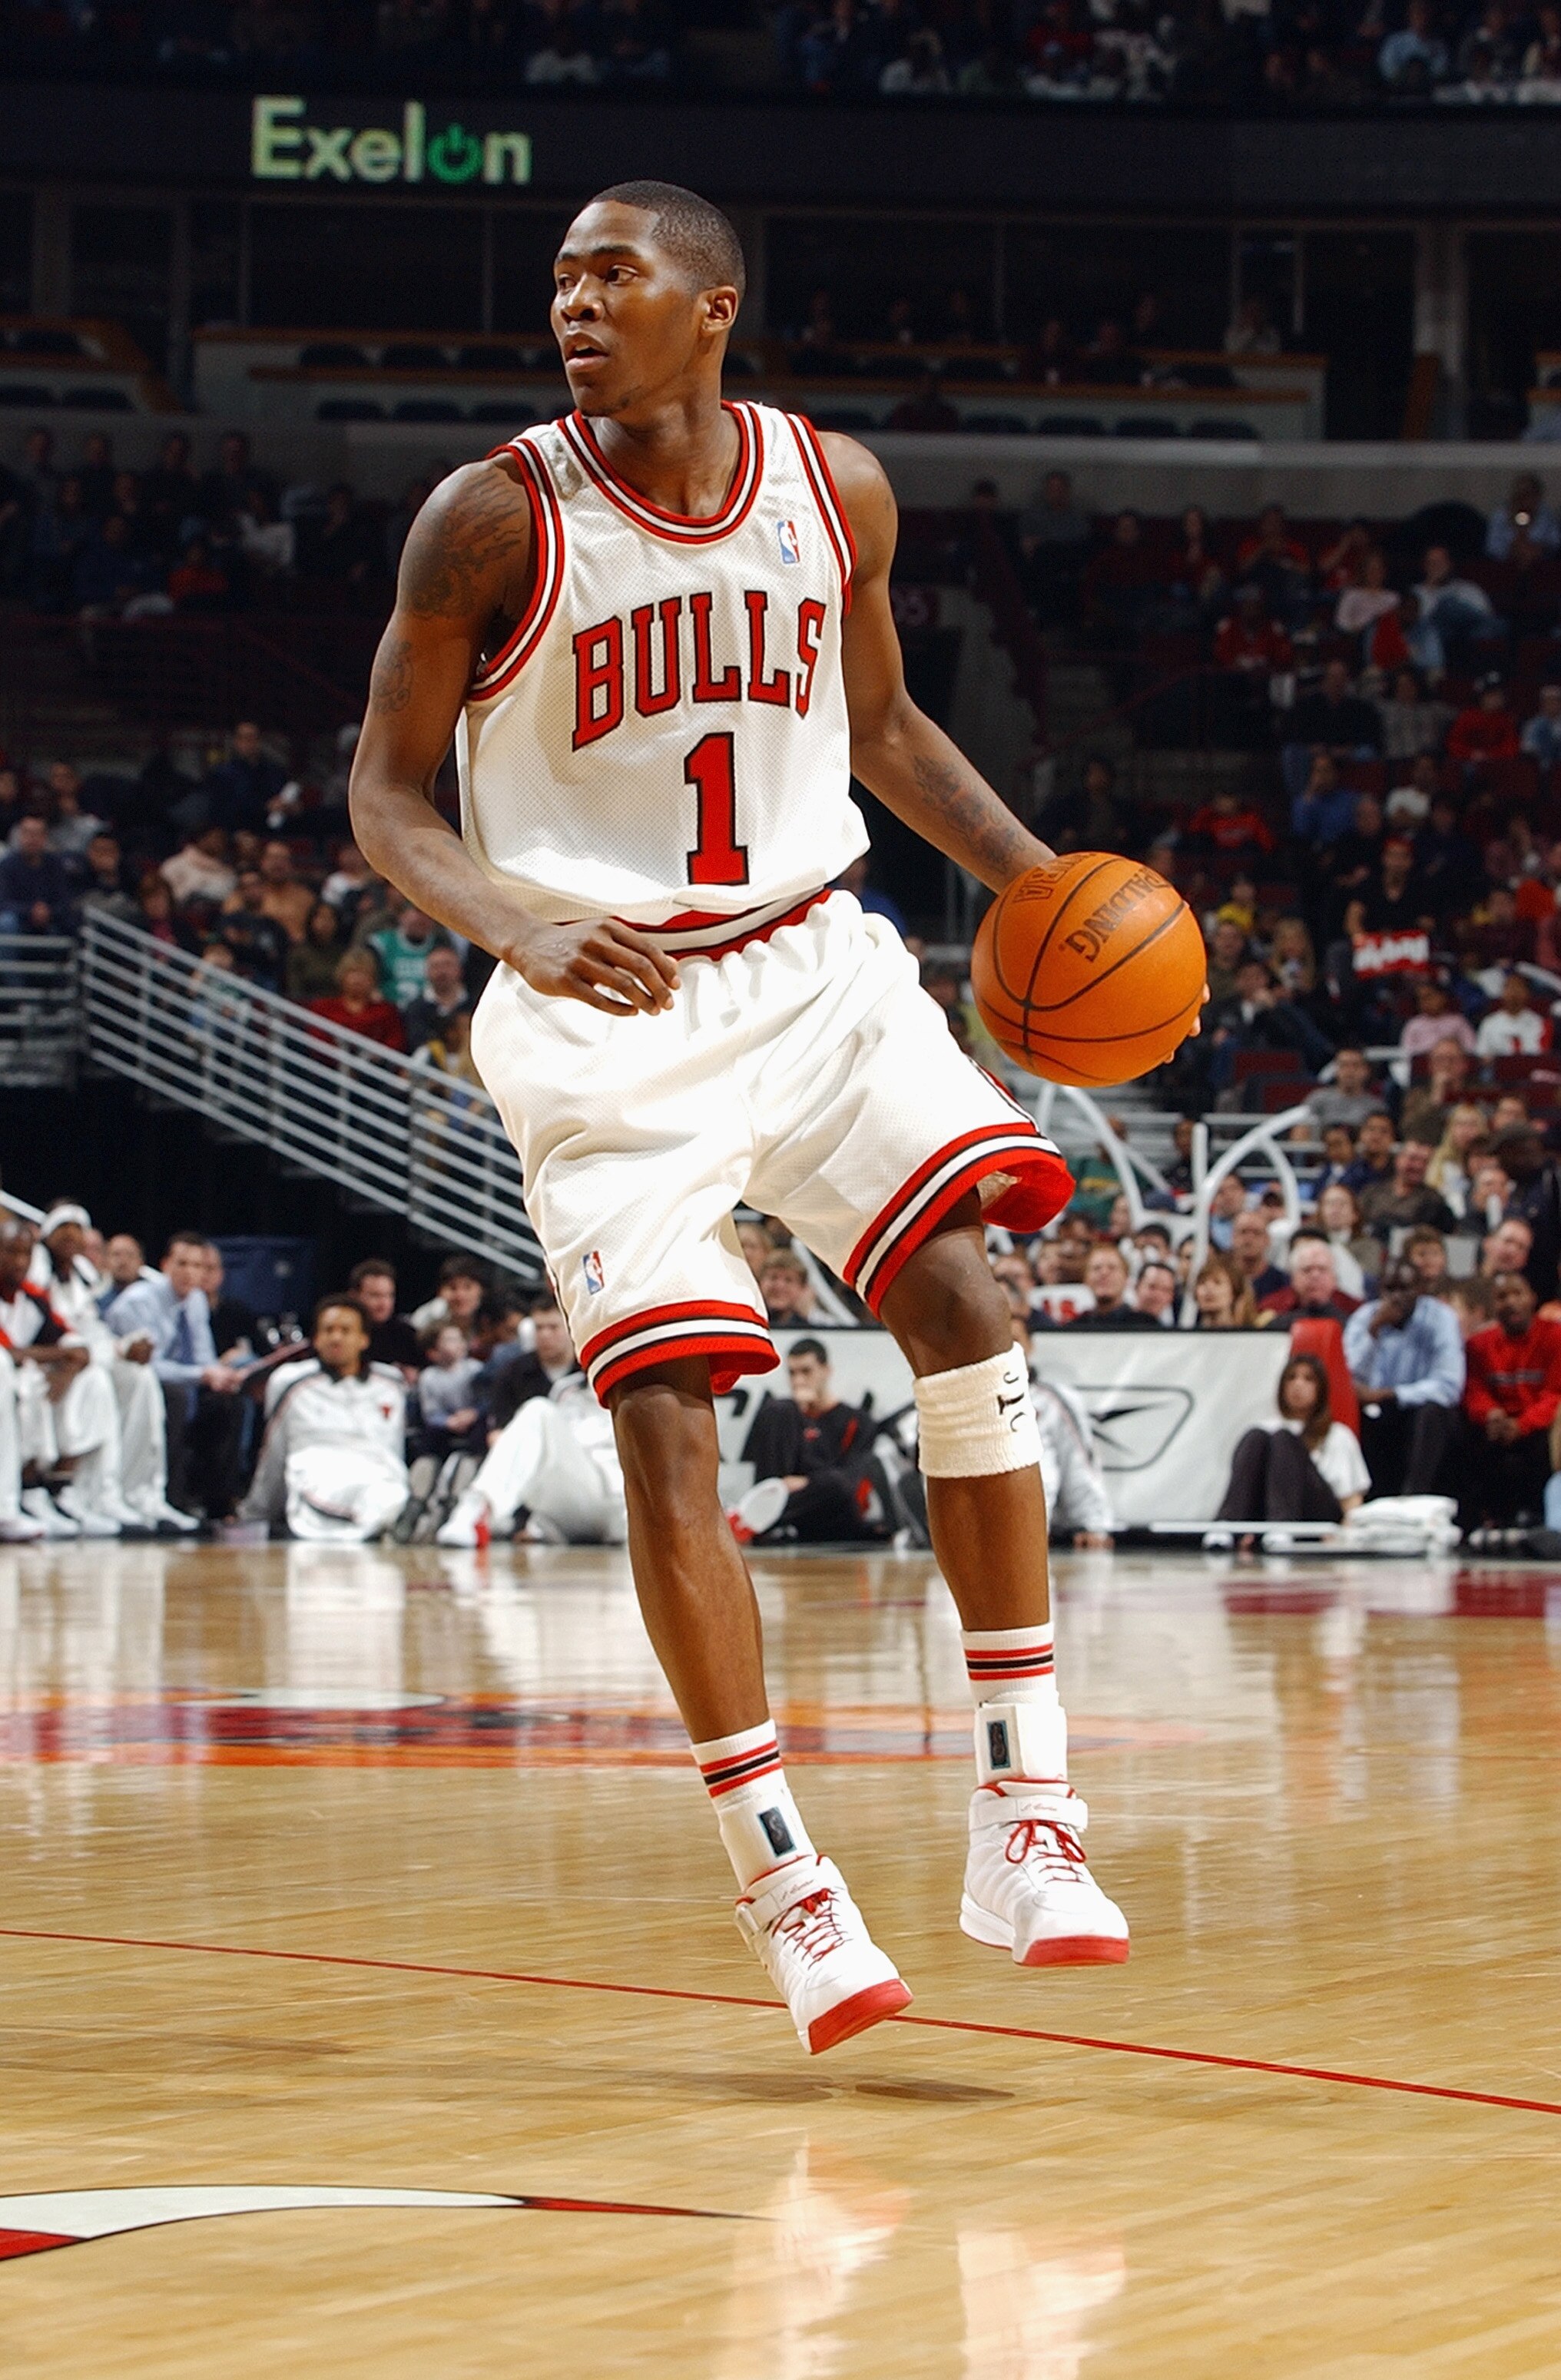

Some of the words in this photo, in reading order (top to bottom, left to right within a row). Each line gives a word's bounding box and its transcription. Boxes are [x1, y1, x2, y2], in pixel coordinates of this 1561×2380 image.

[251, 94, 533, 185] Exelon
[572, 590, 827, 752] BULLS
[684, 731, 750, 885] 1
[1064, 865, 1172, 963] PALDING
